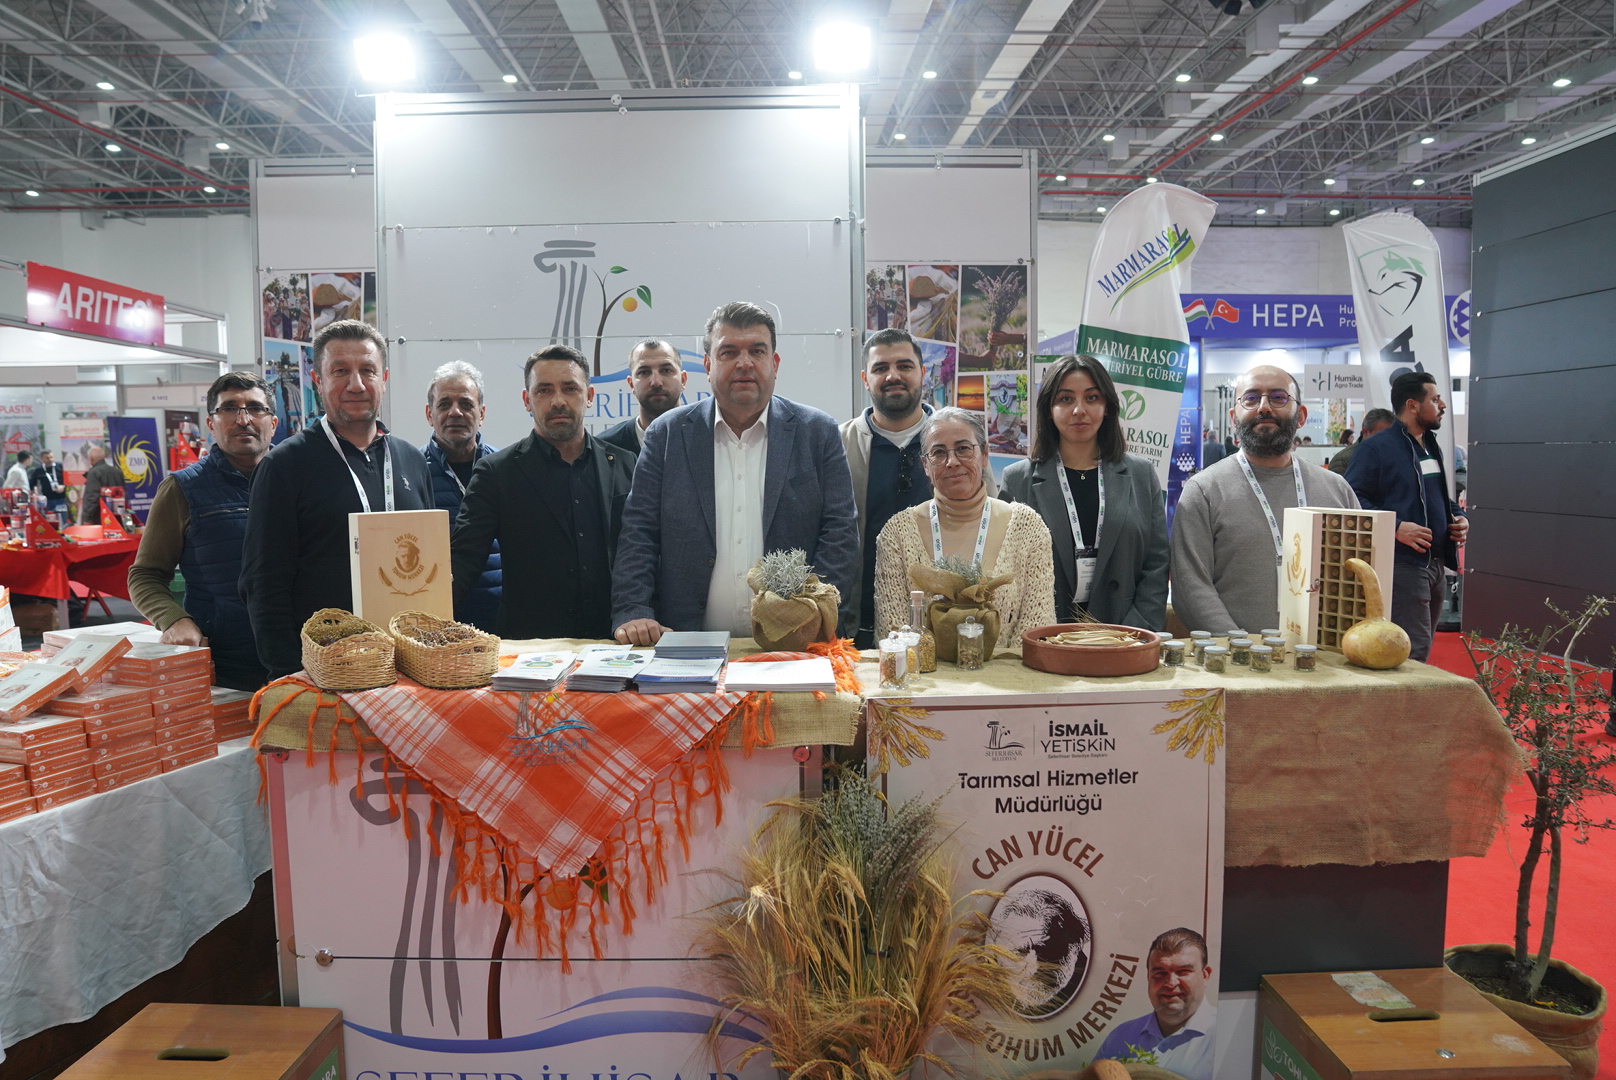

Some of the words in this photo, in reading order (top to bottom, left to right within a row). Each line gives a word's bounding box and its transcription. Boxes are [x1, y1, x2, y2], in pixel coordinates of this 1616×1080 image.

[1252, 304, 1324, 327] HEPA
[1086, 337, 1186, 369] MARMARASOL
[1146, 366, 1183, 383] GÜBRE
[1120, 427, 1170, 448] RASOL
[1180, 410, 1191, 444] HEPA
[128, 456, 146, 466] ZMO
[1048, 718, 1108, 737] İSMAİL
[958, 771, 1040, 789] Tarımsal
[1048, 768, 1138, 786] Hizmetler
[995, 794, 1102, 815] Müdürlüğü
[972, 835, 1024, 880] CAN
[1027, 824, 1104, 878] YÜCEL
[985, 1022, 1065, 1062] TOHUM
[1066, 953, 1140, 1050] MERKEZİ
